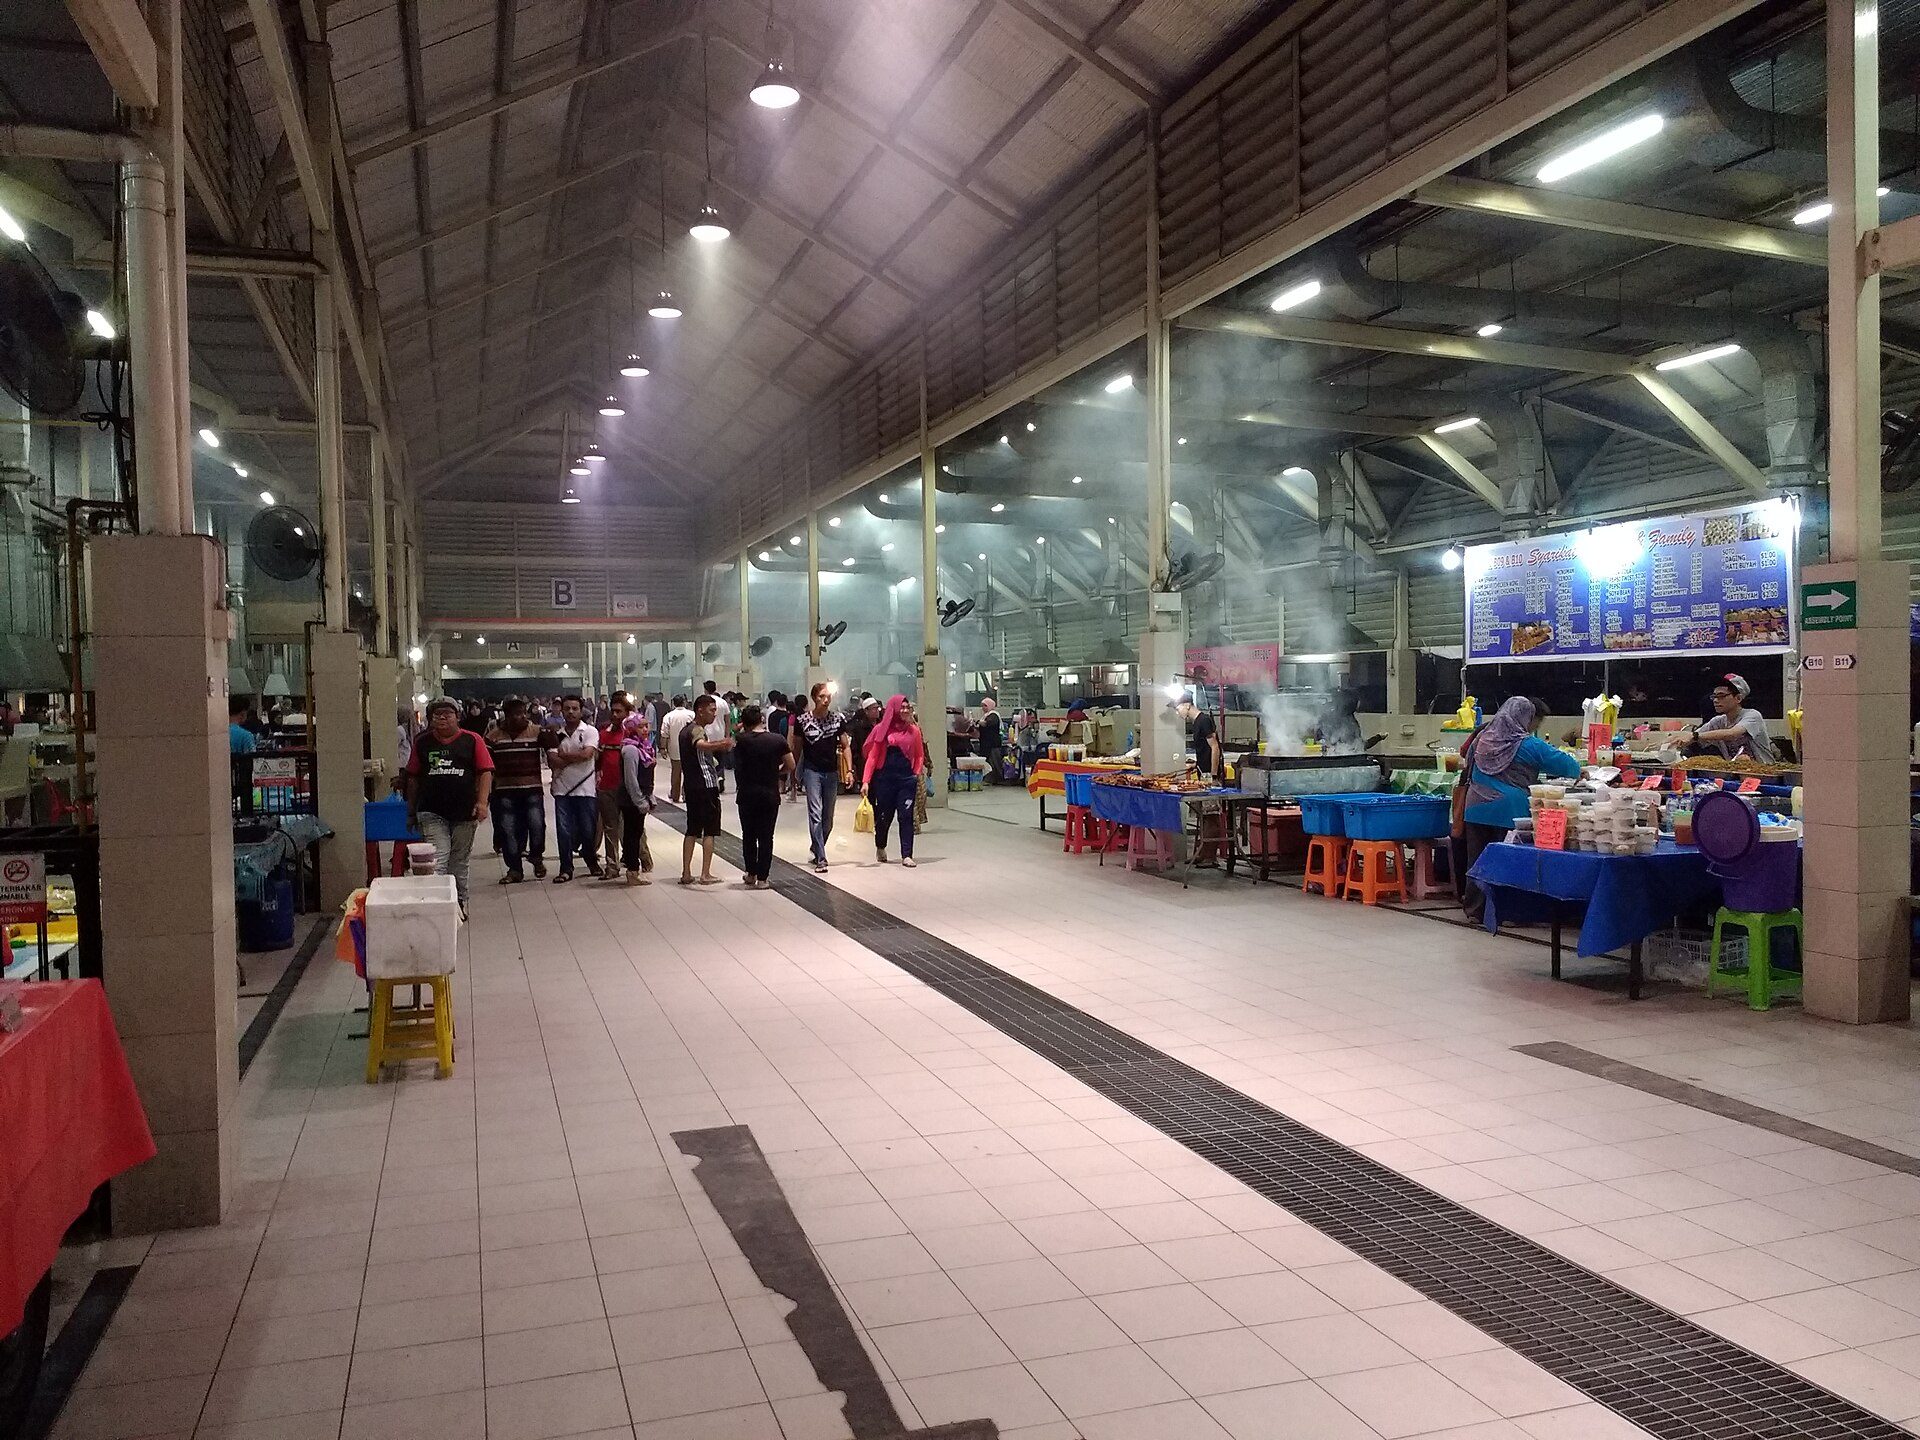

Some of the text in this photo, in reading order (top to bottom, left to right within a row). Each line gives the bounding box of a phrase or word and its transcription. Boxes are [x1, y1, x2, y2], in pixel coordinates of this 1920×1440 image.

[1511, 553, 1523, 566] B10
[1648, 526, 1697, 553] Family
[1761, 551, 1776, 559] $1.00
[1761, 559, 1777, 567] $1.00
[555, 580, 573, 606] B
[1727, 585, 1747, 593] TULANG
[1740, 591, 1758, 599] BUYAH
[1762, 590, 1778, 598] $2.00
[1834, 614, 1854, 623] POINT
[1690, 633, 1711, 643] $1.00
[508, 642, 519, 651] A
[1808, 658, 1823, 667] B10
[1835, 657, 1849, 666] B11
[428, 751, 441, 768] 5
[438, 758, 453, 766] Car
